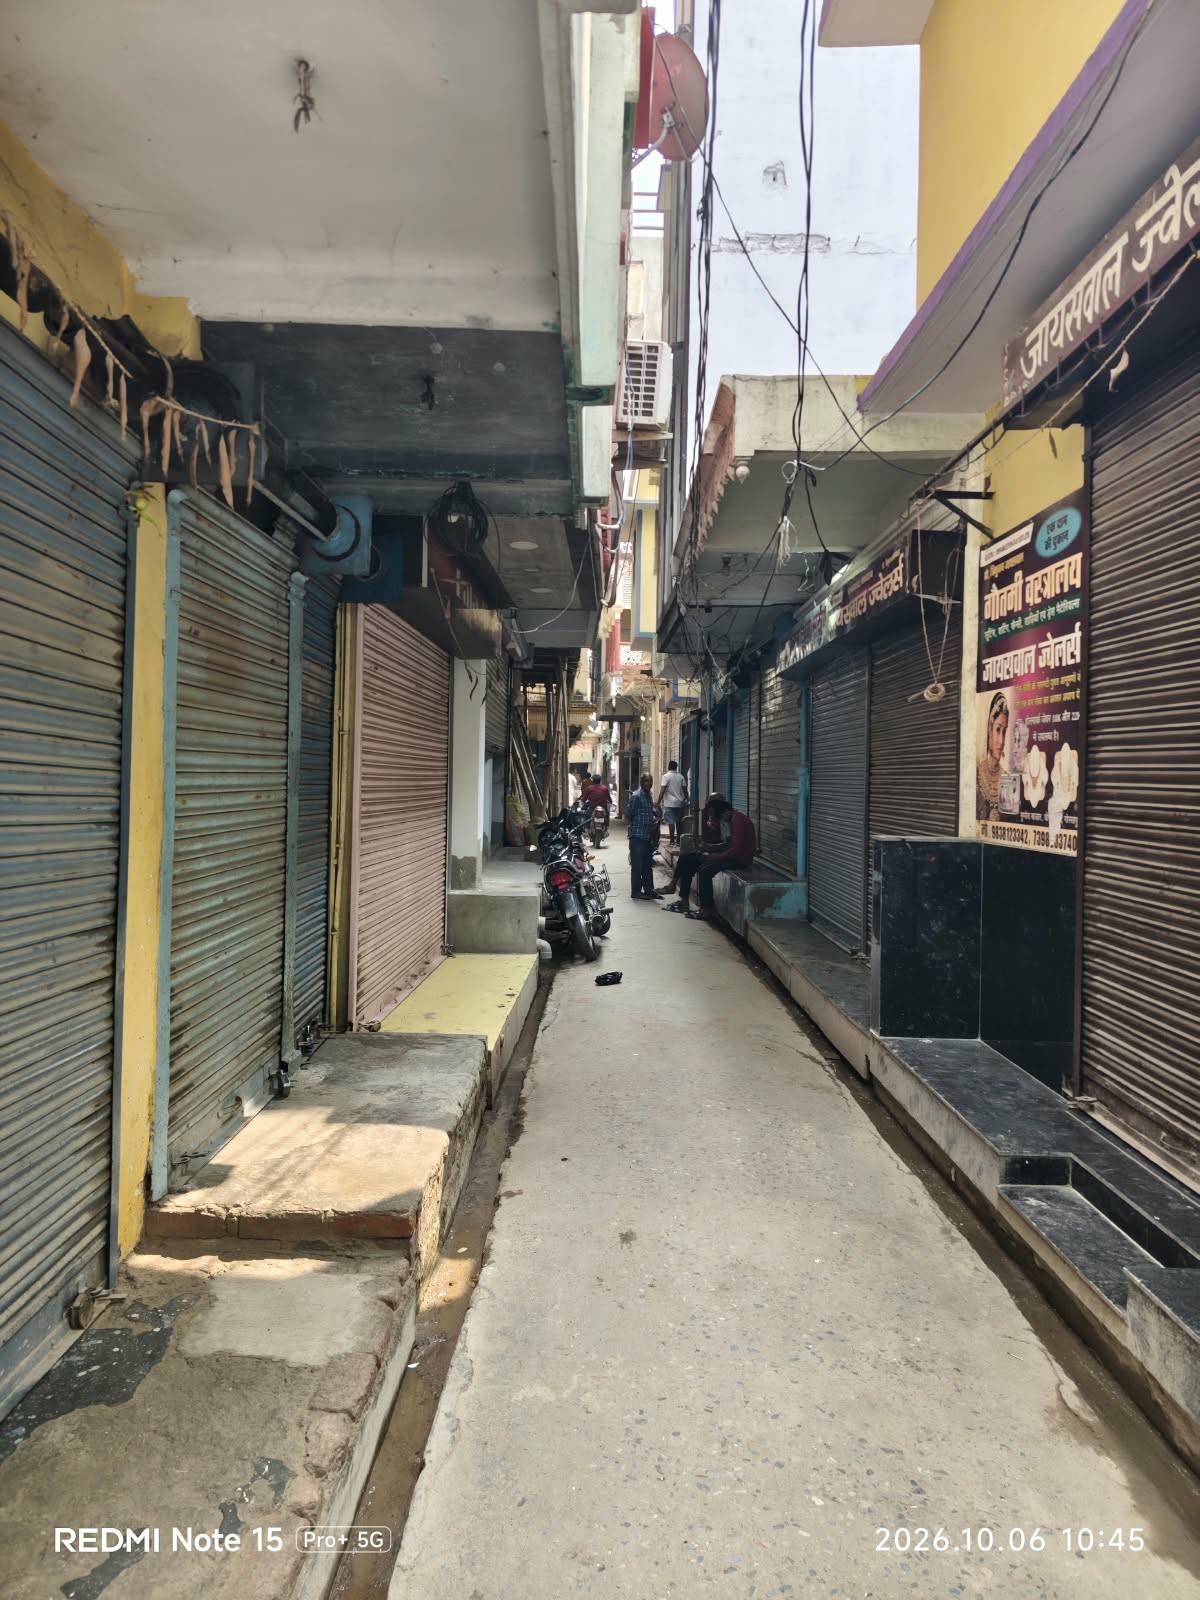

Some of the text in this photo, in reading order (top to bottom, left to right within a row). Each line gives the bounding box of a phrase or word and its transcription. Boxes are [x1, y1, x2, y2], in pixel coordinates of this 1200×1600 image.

[1020, 231, 1129, 379] जायसवाल
[983, 569, 1024, 621] गौतमी
[1025, 551, 1083, 606] वस्त्रालय
[982, 644, 1036, 684] जायसवाल
[1038, 621, 1082, 669] ज्वेलर्स
[1033, 830, 1078, 851] 739833740
